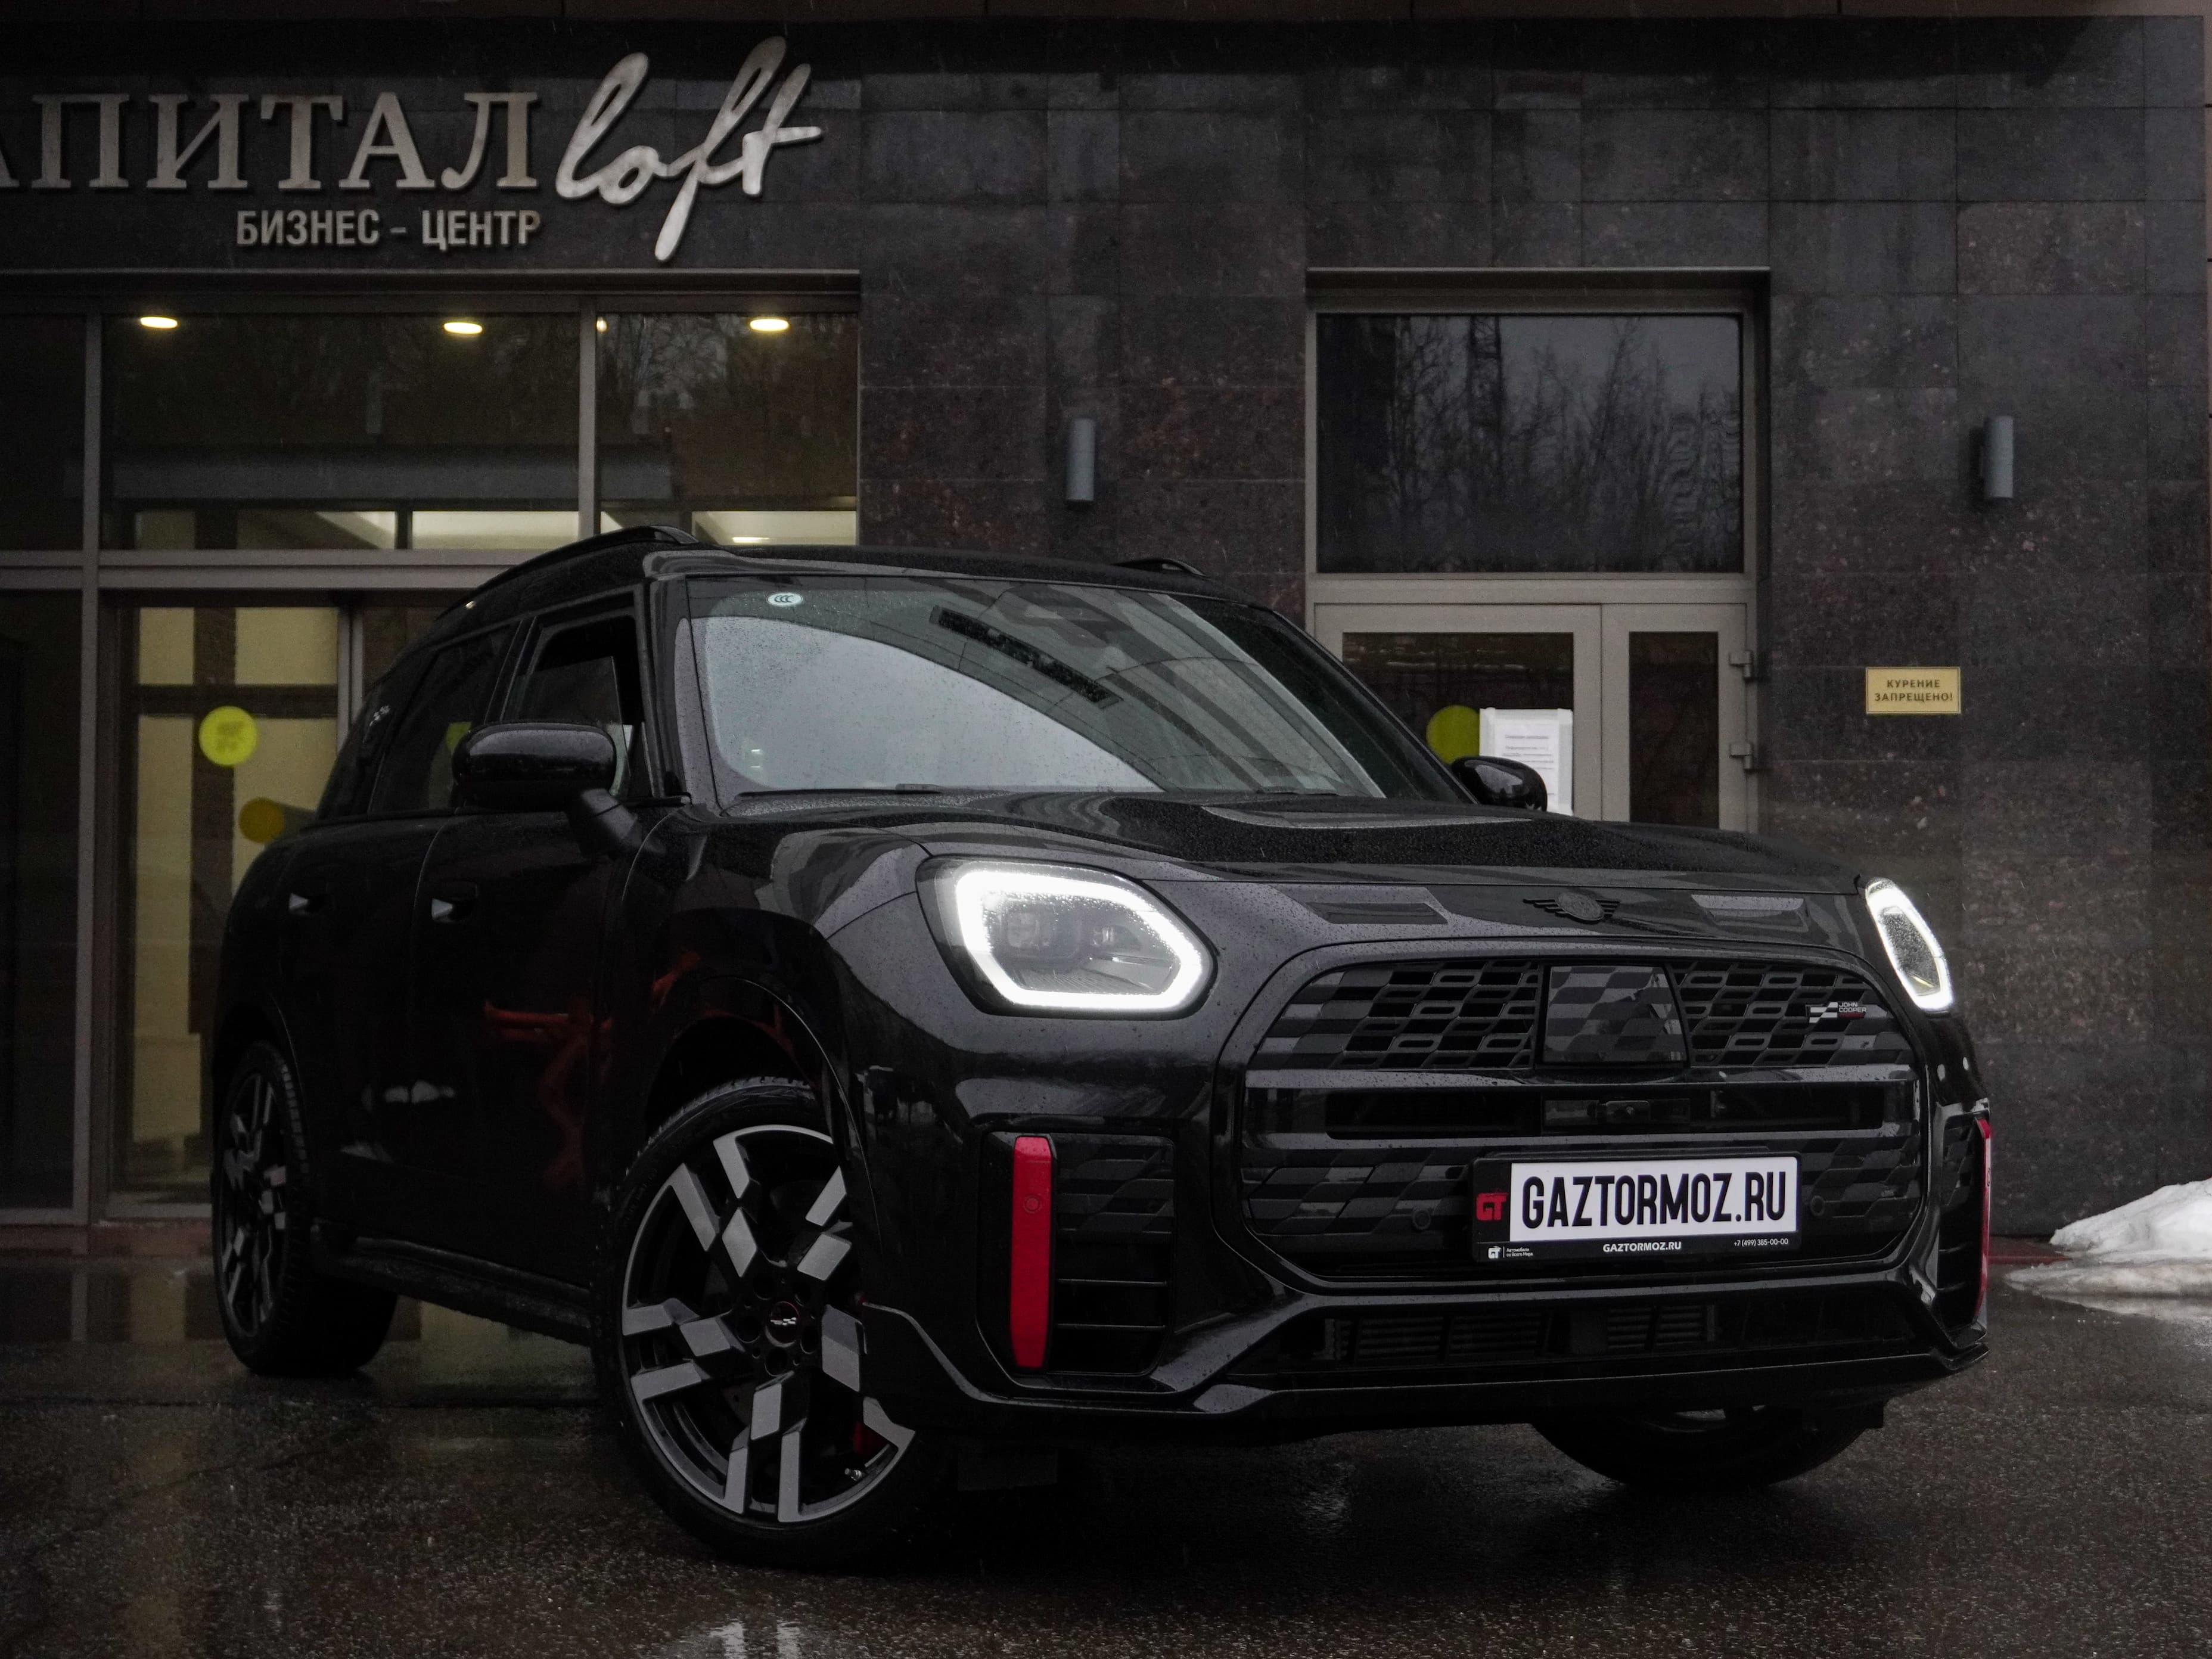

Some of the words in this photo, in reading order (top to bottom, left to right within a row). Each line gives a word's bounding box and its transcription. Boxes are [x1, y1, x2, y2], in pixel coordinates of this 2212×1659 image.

[0, 92, 538, 189] ПИТАЛ
[555, 36, 821, 260] loft
[237, 210, 380, 246] БИЗНЕС
[421, 209, 540, 250] ЦЕНТР
[1875, 692, 1953, 702] ЗАПРЕЩЕНО!
[1887, 679, 1940, 688] КУРЕНИЕ
[1522, 1172, 1786, 1229] GAZTORMOZ.RU
[1603, 1241, 1682, 1253] GAZTORMOZ.RU
